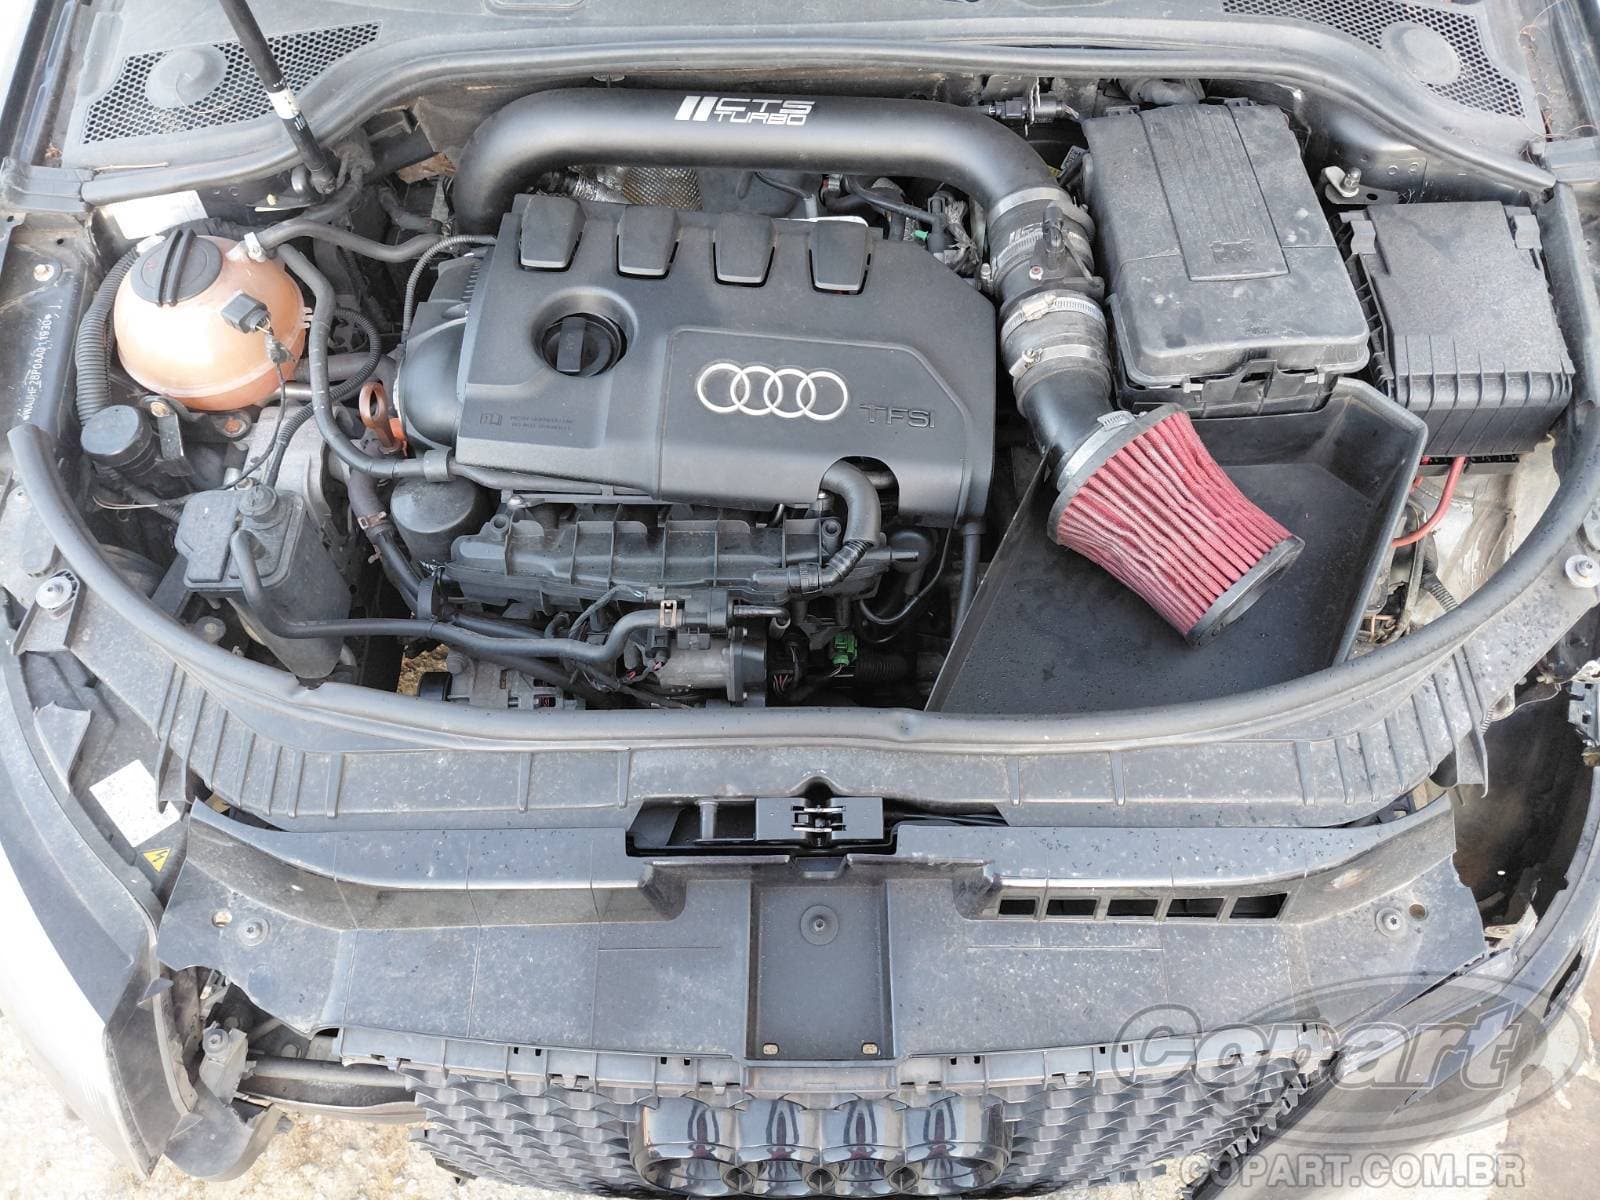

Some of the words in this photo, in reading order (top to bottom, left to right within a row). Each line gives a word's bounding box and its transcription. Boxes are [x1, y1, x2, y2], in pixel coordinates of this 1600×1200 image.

[716, 97, 816, 115] CTS
[713, 110, 808, 126] TURBO
[859, 403, 936, 428] TFSI
